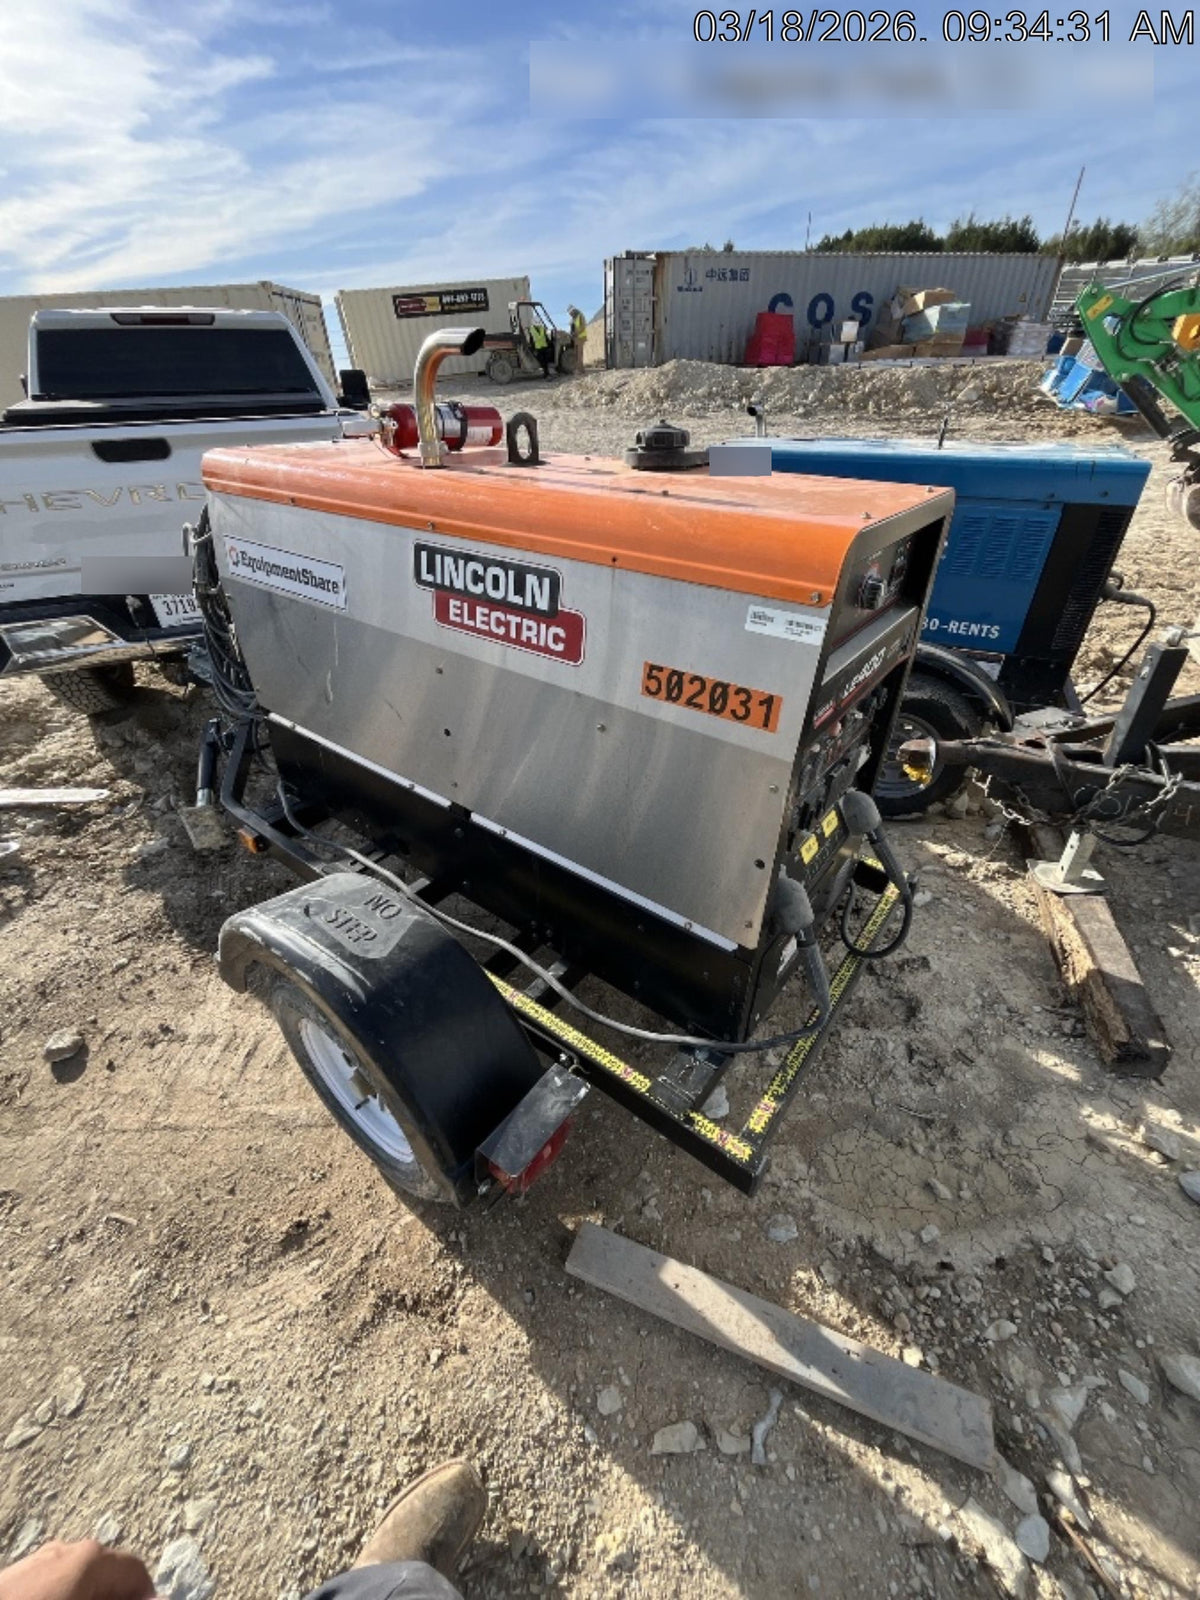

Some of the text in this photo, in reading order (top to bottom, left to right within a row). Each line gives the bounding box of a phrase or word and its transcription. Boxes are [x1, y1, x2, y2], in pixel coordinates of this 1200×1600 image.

[240, 550, 340, 595] EquipmentShare
[420, 550, 551, 611] LINCOLN
[448, 598, 567, 653] ELECTRIC
[644, 663, 776, 729] 502031
[325, 908, 378, 943] STEP
[363, 894, 402, 920] NO
